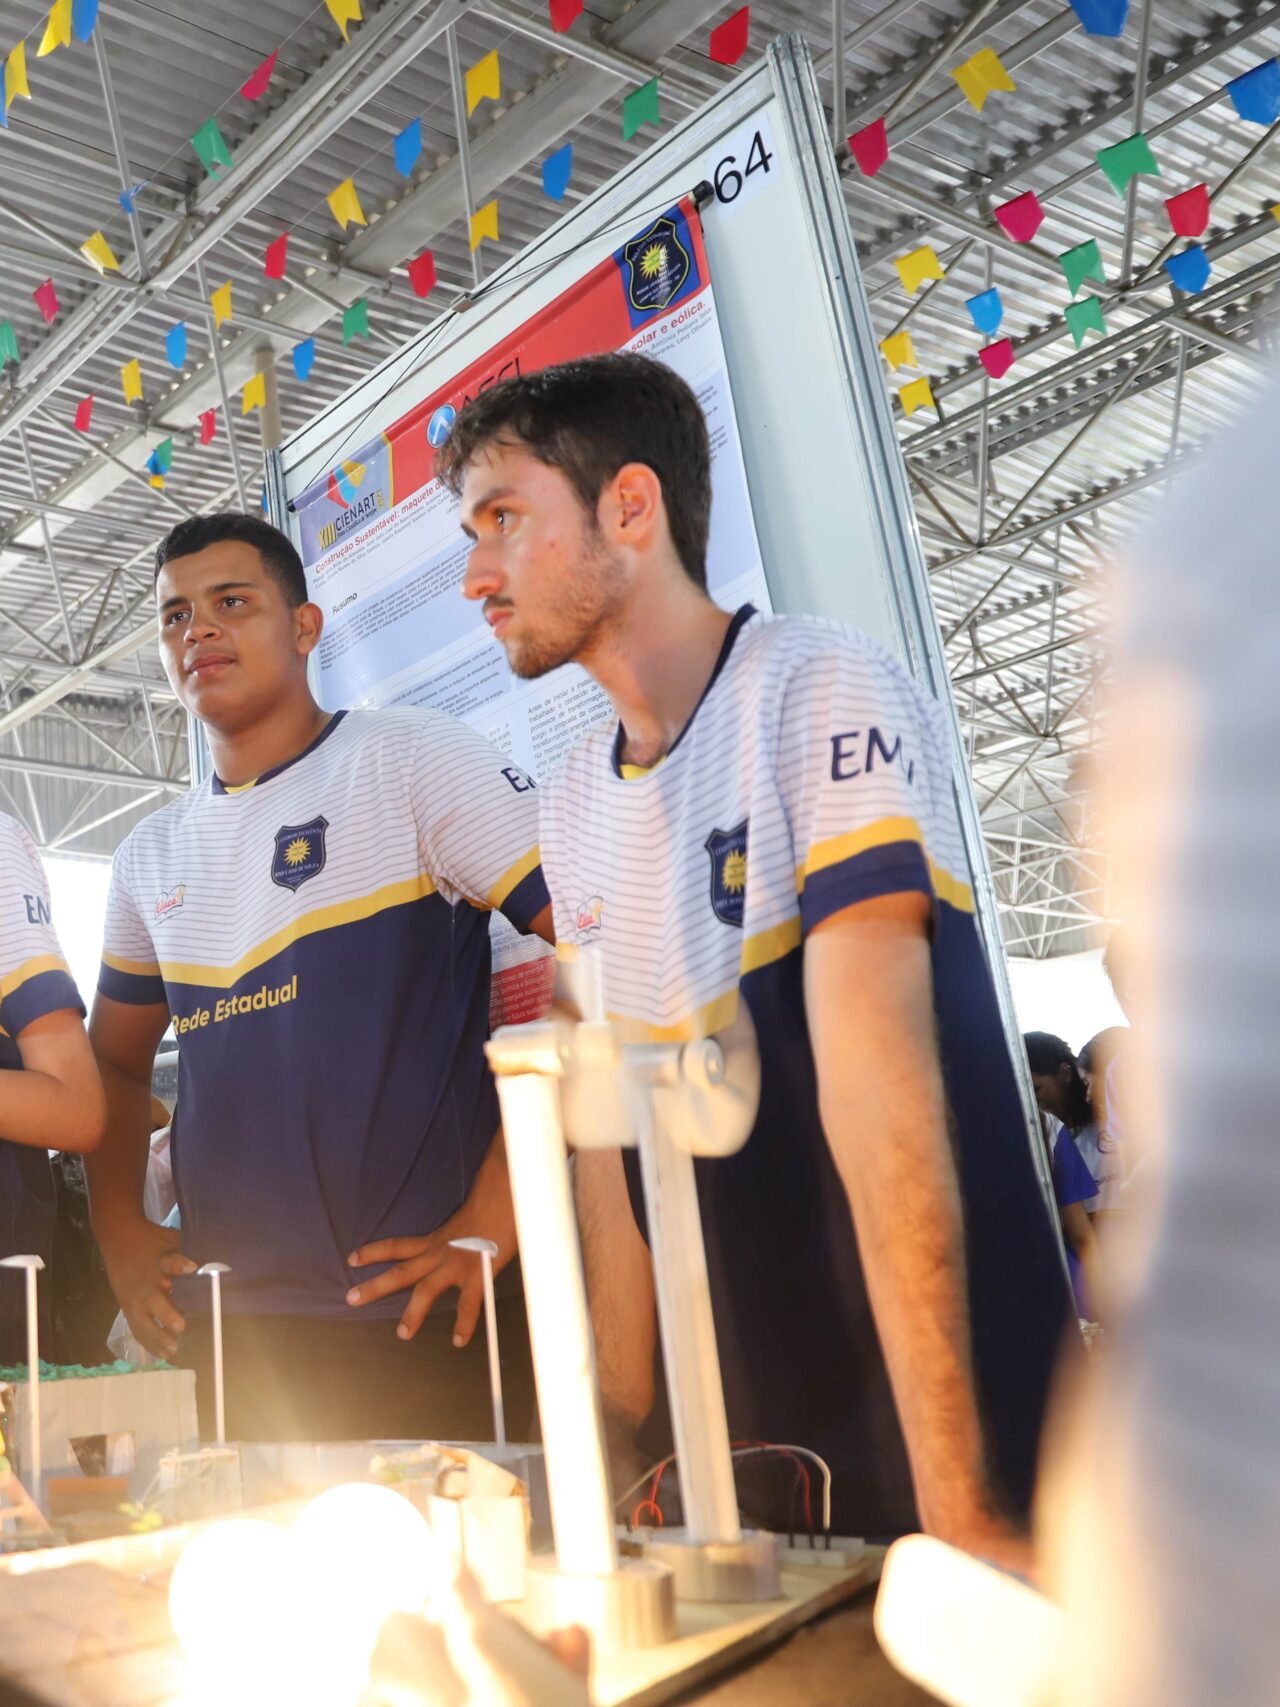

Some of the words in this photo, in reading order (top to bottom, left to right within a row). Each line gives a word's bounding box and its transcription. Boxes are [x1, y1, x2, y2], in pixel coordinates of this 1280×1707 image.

[713, 130, 773, 204] 64
[316, 543, 354, 574] Construção
[355, 511, 400, 546] Sustentável:
[401, 486, 434, 515] maquete
[631, 329, 657, 354] solar
[660, 325, 668, 334] e
[670, 301, 706, 329] eólica.
[335, 492, 375, 531] CIENART
[332, 592, 358, 616] Resumo
[172, 1007, 210, 1036] Rede
[214, 974, 298, 1024] Estadual
